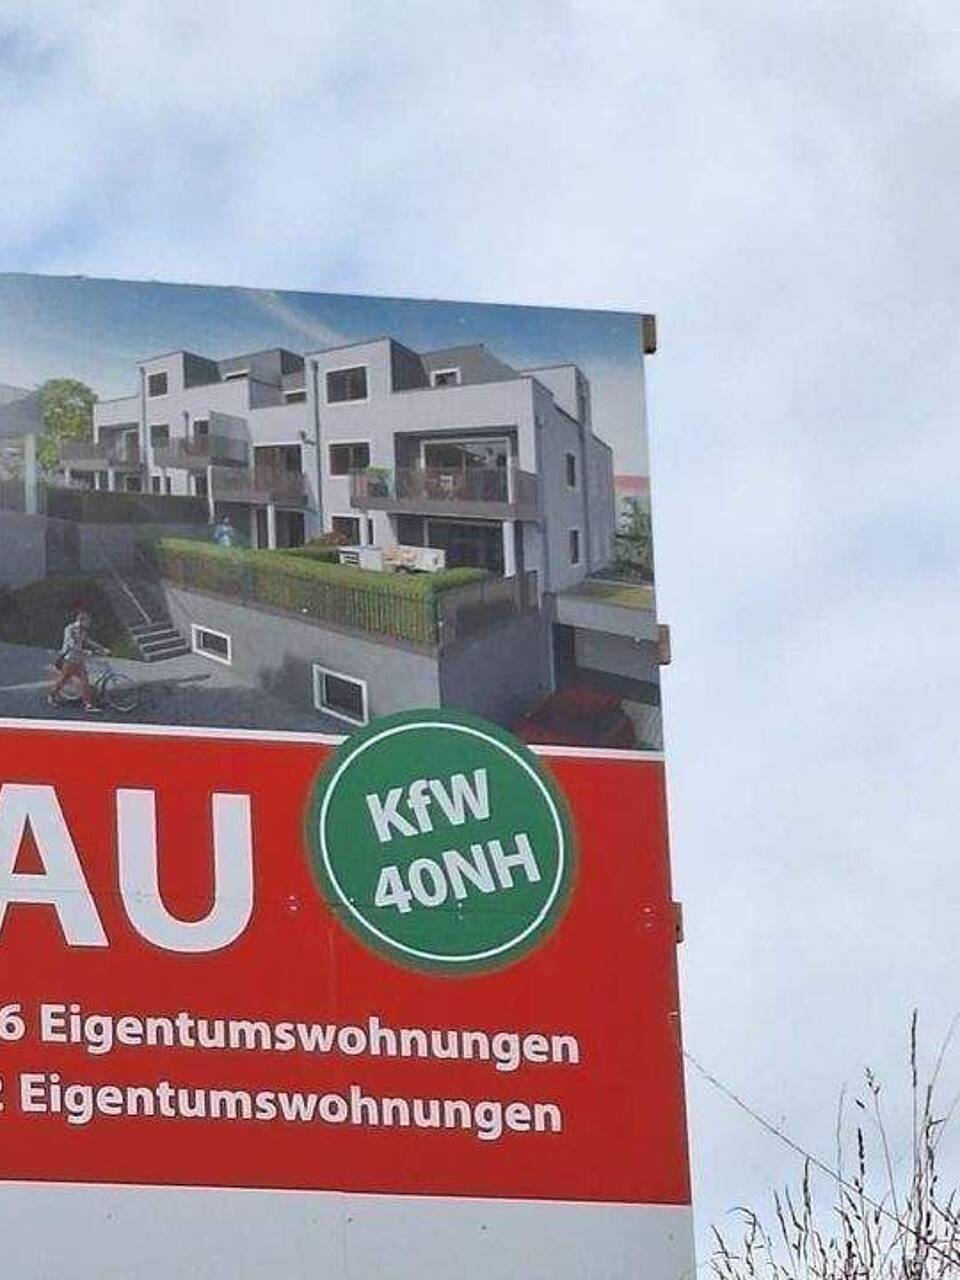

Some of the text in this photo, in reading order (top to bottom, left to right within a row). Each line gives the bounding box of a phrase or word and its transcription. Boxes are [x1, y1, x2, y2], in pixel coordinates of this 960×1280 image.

[366, 768, 492, 843] KfW
[373, 833, 542, 915] 40NH
[40, 1004, 580, 1072] Eigentumswohnungen
[20, 1073, 562, 1140] Eigentumswohnungen
